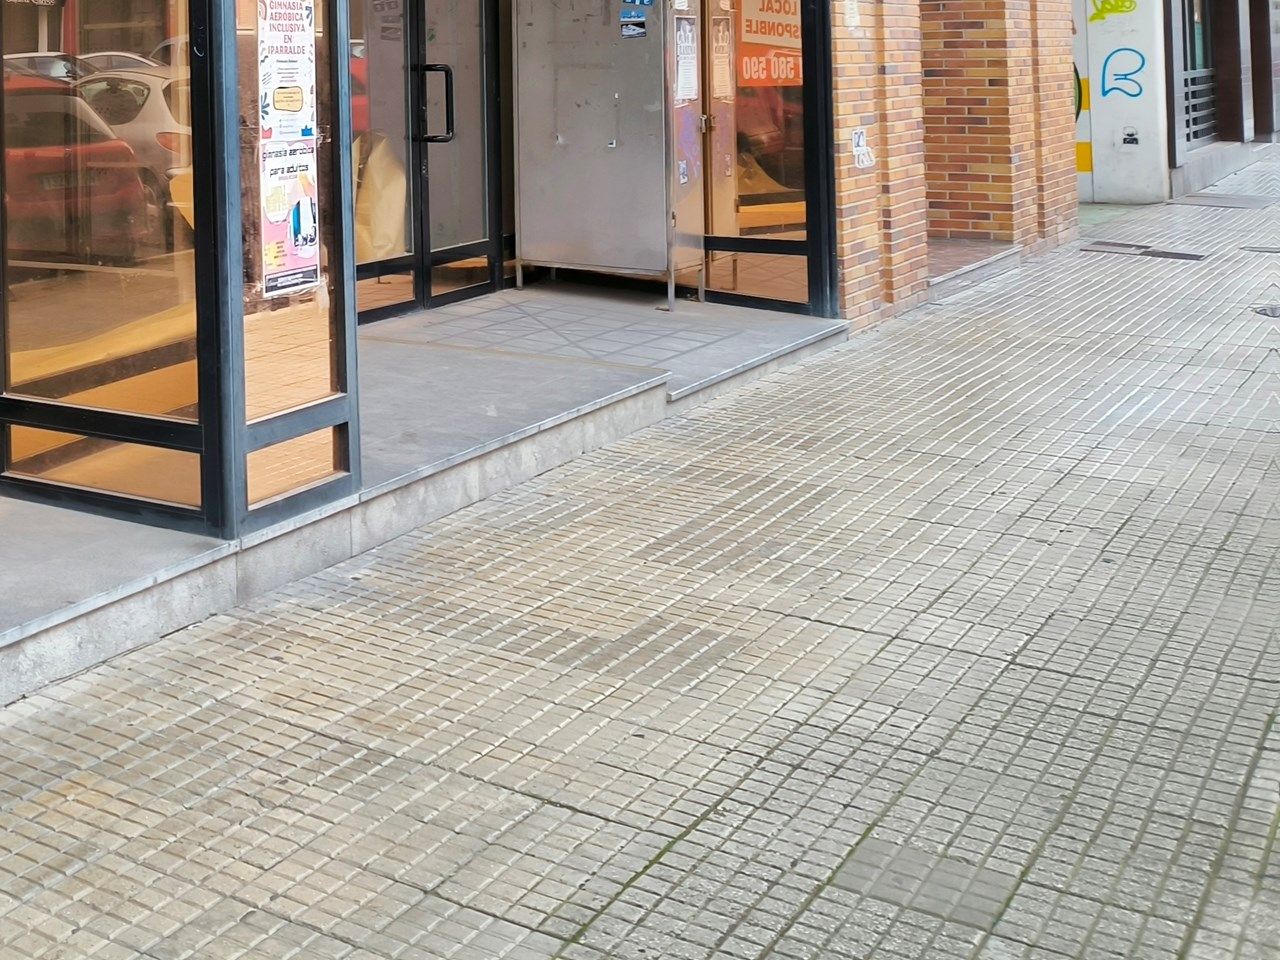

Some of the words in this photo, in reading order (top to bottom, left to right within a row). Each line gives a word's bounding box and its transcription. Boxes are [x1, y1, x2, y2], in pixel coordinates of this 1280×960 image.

[269, 1, 304, 11] GIMNASIA
[269, 23, 306, 33] INCLUSIVA
[283, 34, 293, 44] EN
[267, 45, 306, 55] IPARRALDE
